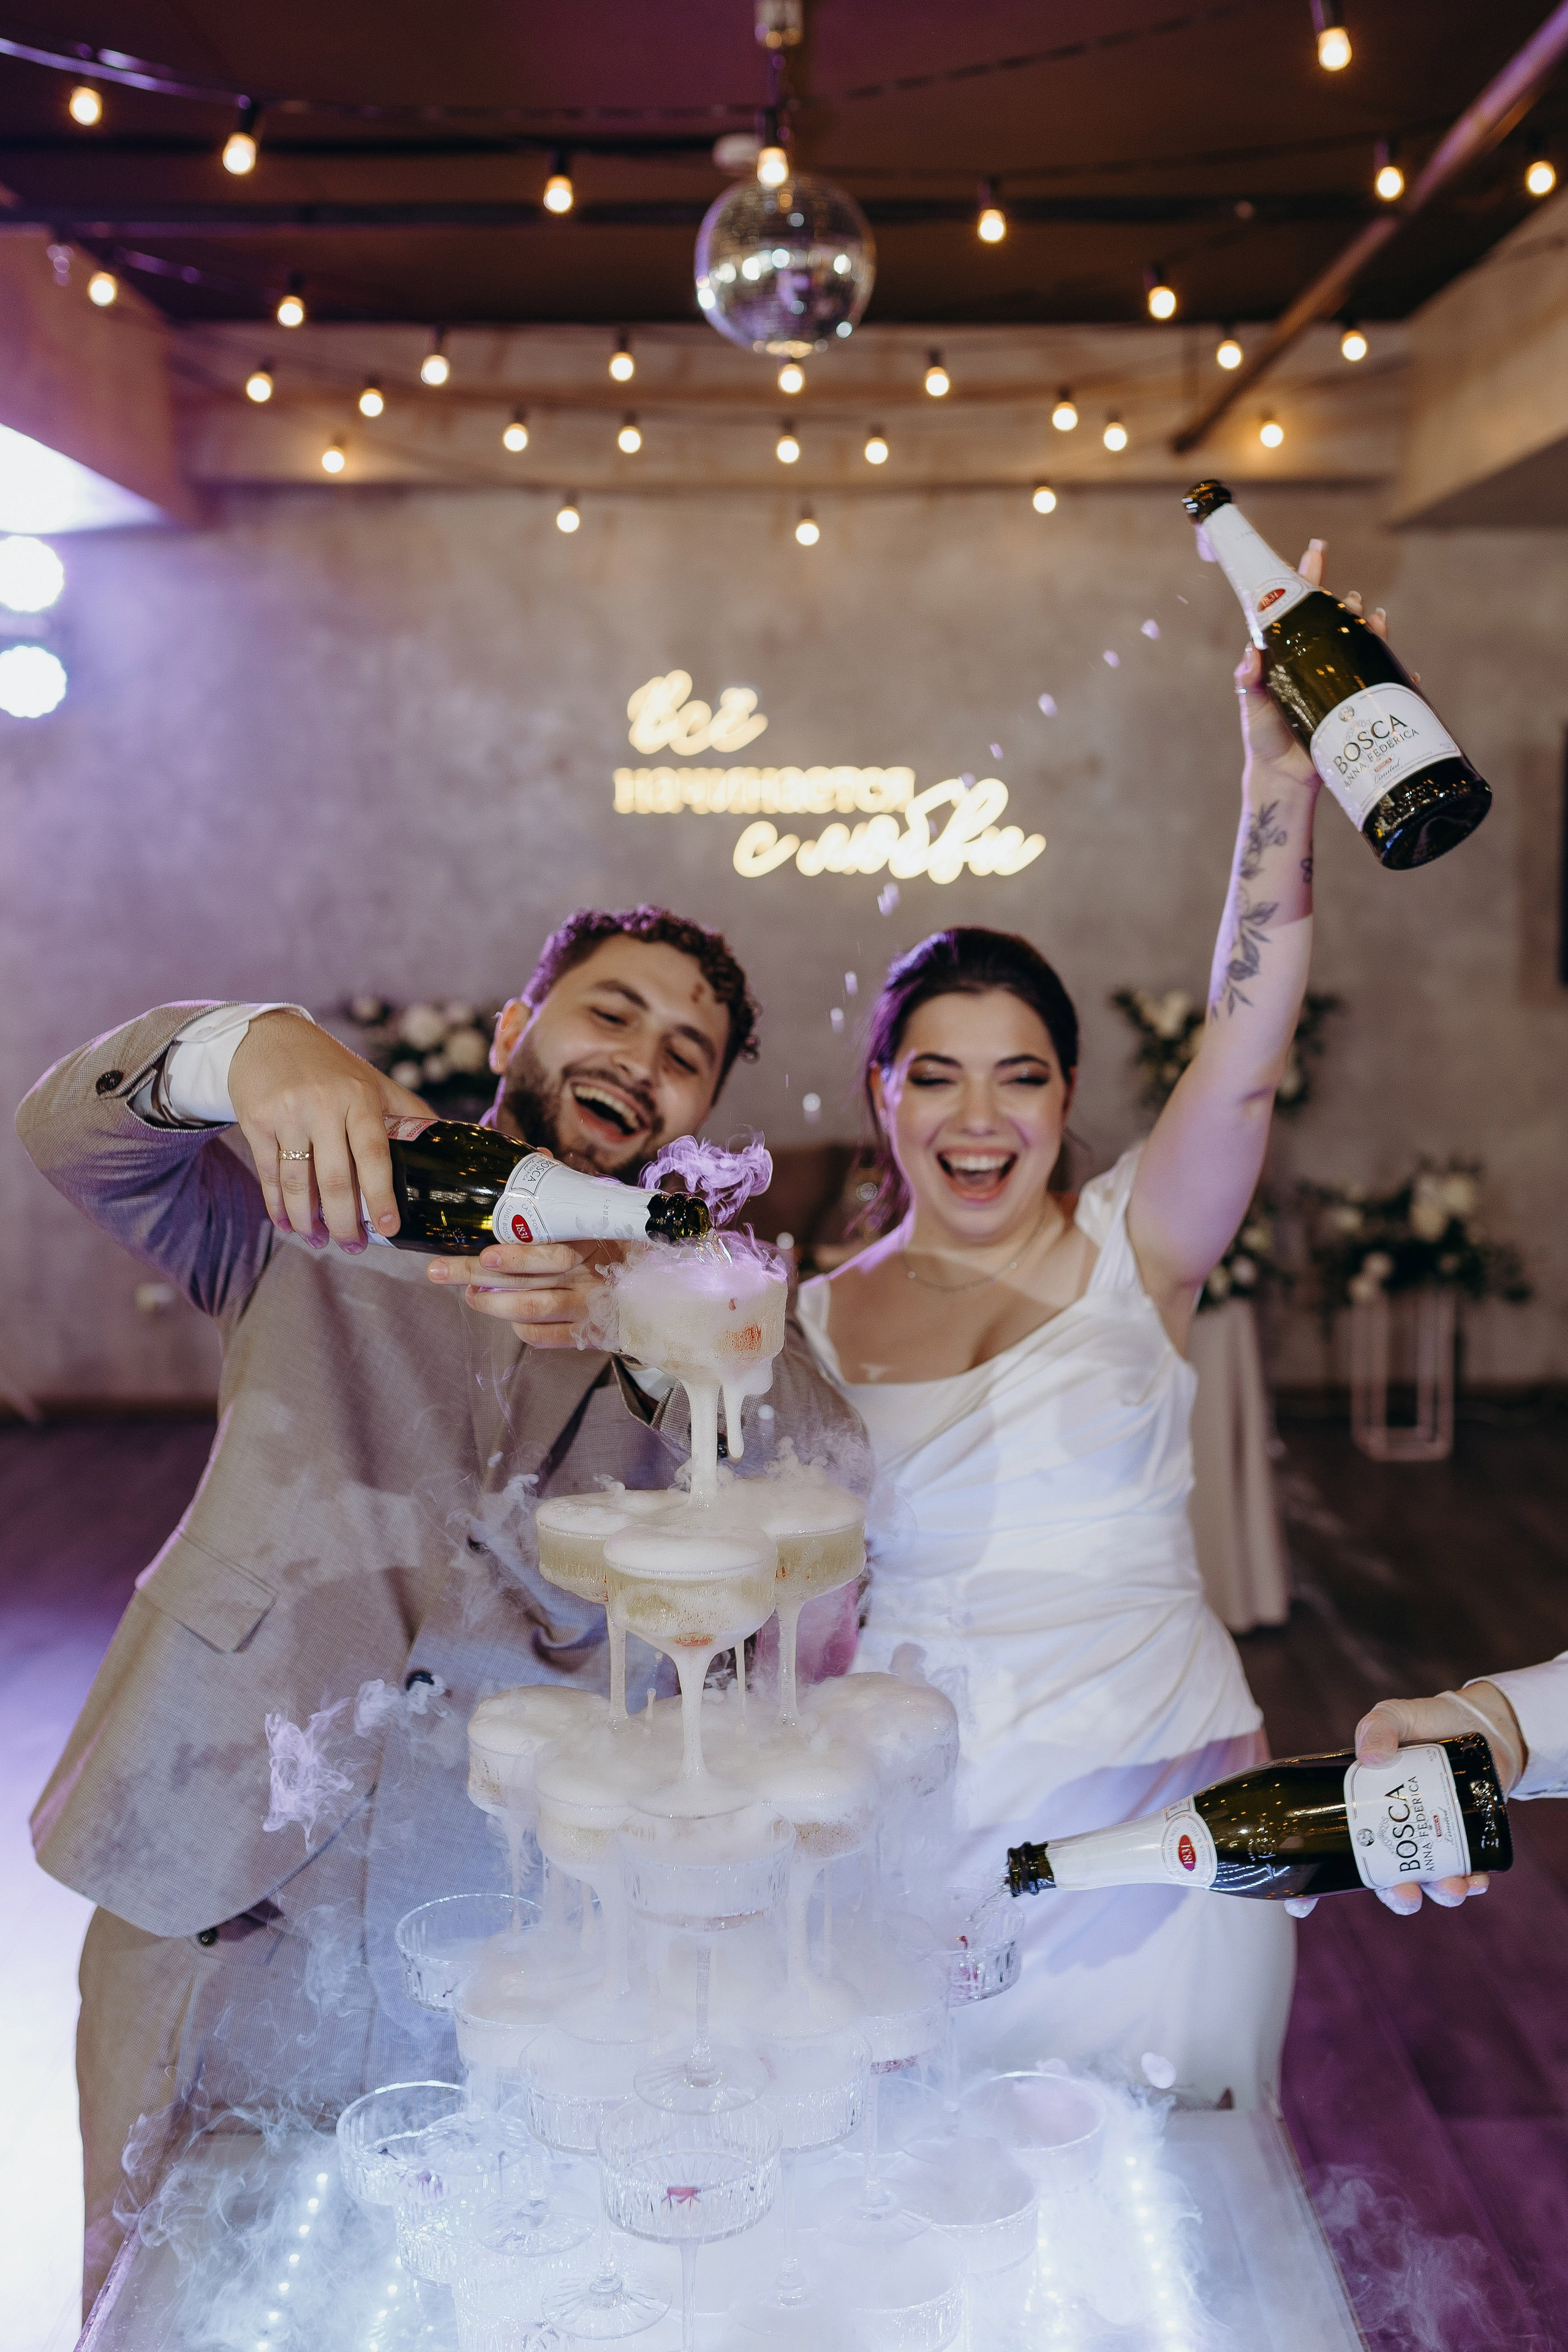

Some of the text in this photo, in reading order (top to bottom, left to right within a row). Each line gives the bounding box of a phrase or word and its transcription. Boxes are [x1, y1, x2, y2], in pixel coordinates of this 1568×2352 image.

[1333, 714, 1408, 775] BOSCA
[1343, 762, 1366, 788] ANNA
[1367, 728, 1419, 763] FEDERICA
[527, 1160, 554, 1182] BOSCA
[503, 1205, 514, 1221] LUIGI
[521, 1203, 533, 1218] CASA
[515, 1223, 529, 1239] 1831
[1384, 1783, 1421, 1872] BOSCA
[1408, 1776, 1435, 1871] ANNA FEDERICA
[1181, 1844, 1194, 1864] 1831
